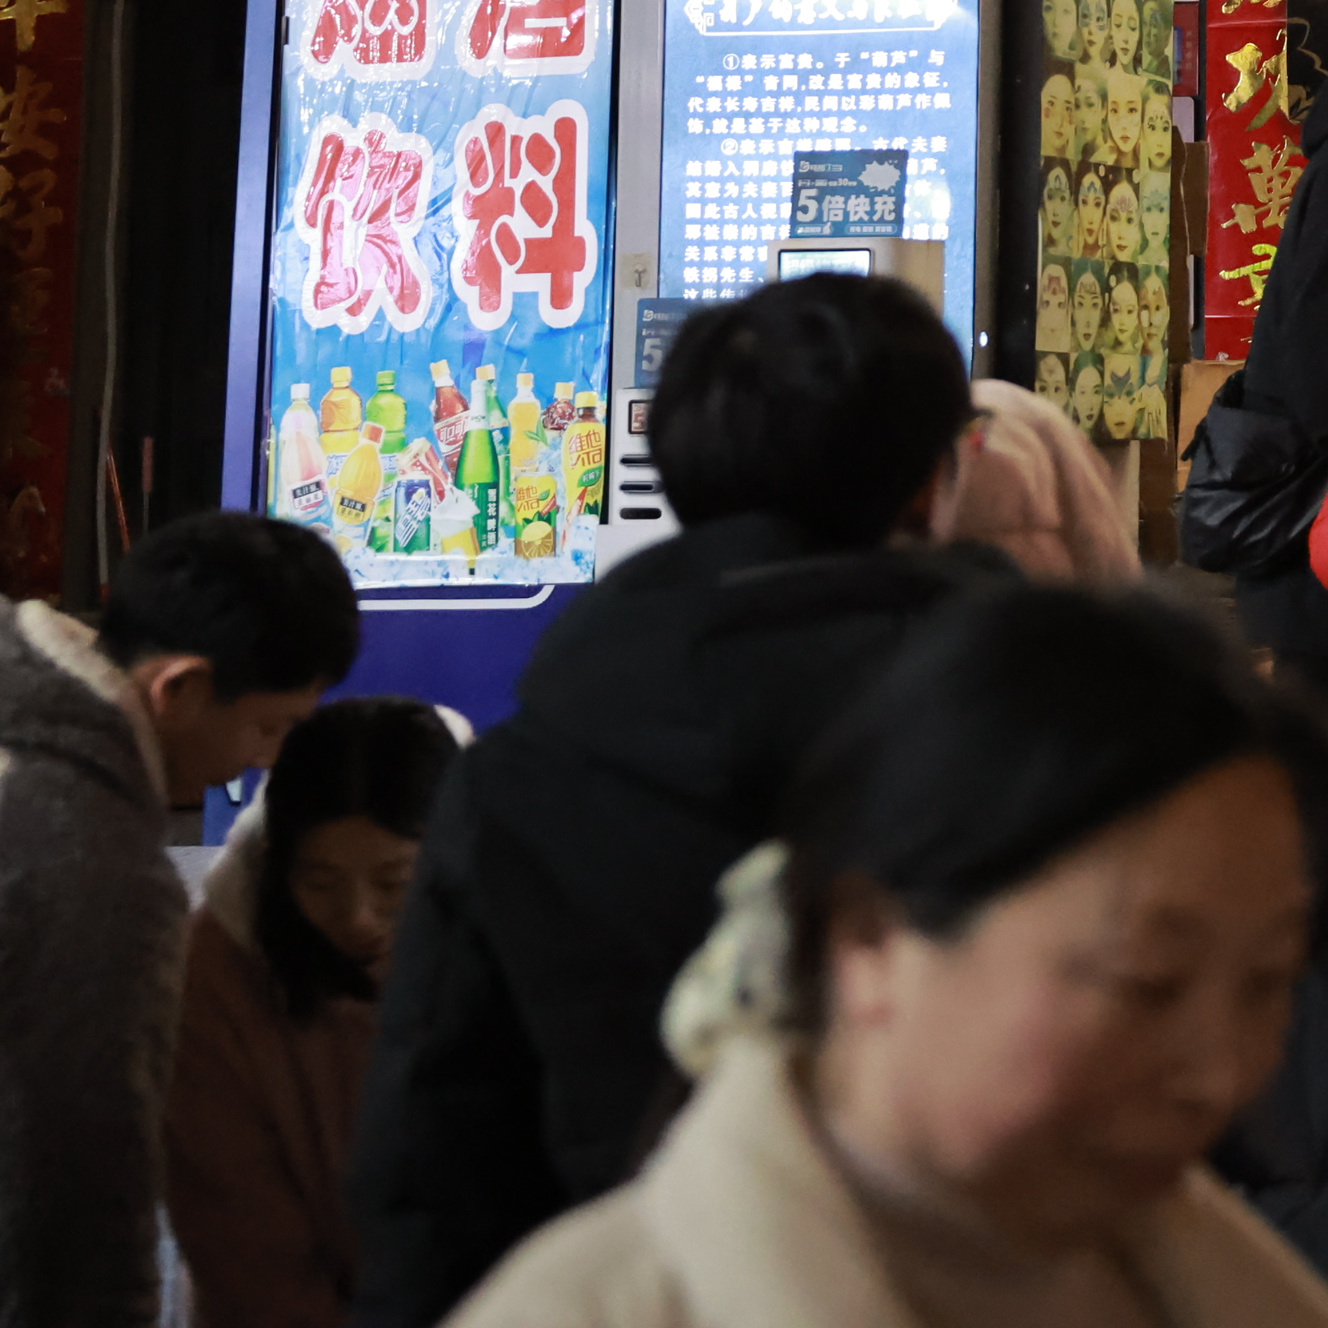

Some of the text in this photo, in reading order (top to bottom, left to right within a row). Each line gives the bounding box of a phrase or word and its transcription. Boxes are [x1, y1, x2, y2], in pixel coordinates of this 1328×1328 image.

[302, 108, 599, 320] 饮料
[795, 187, 897, 223] 5倍快充
